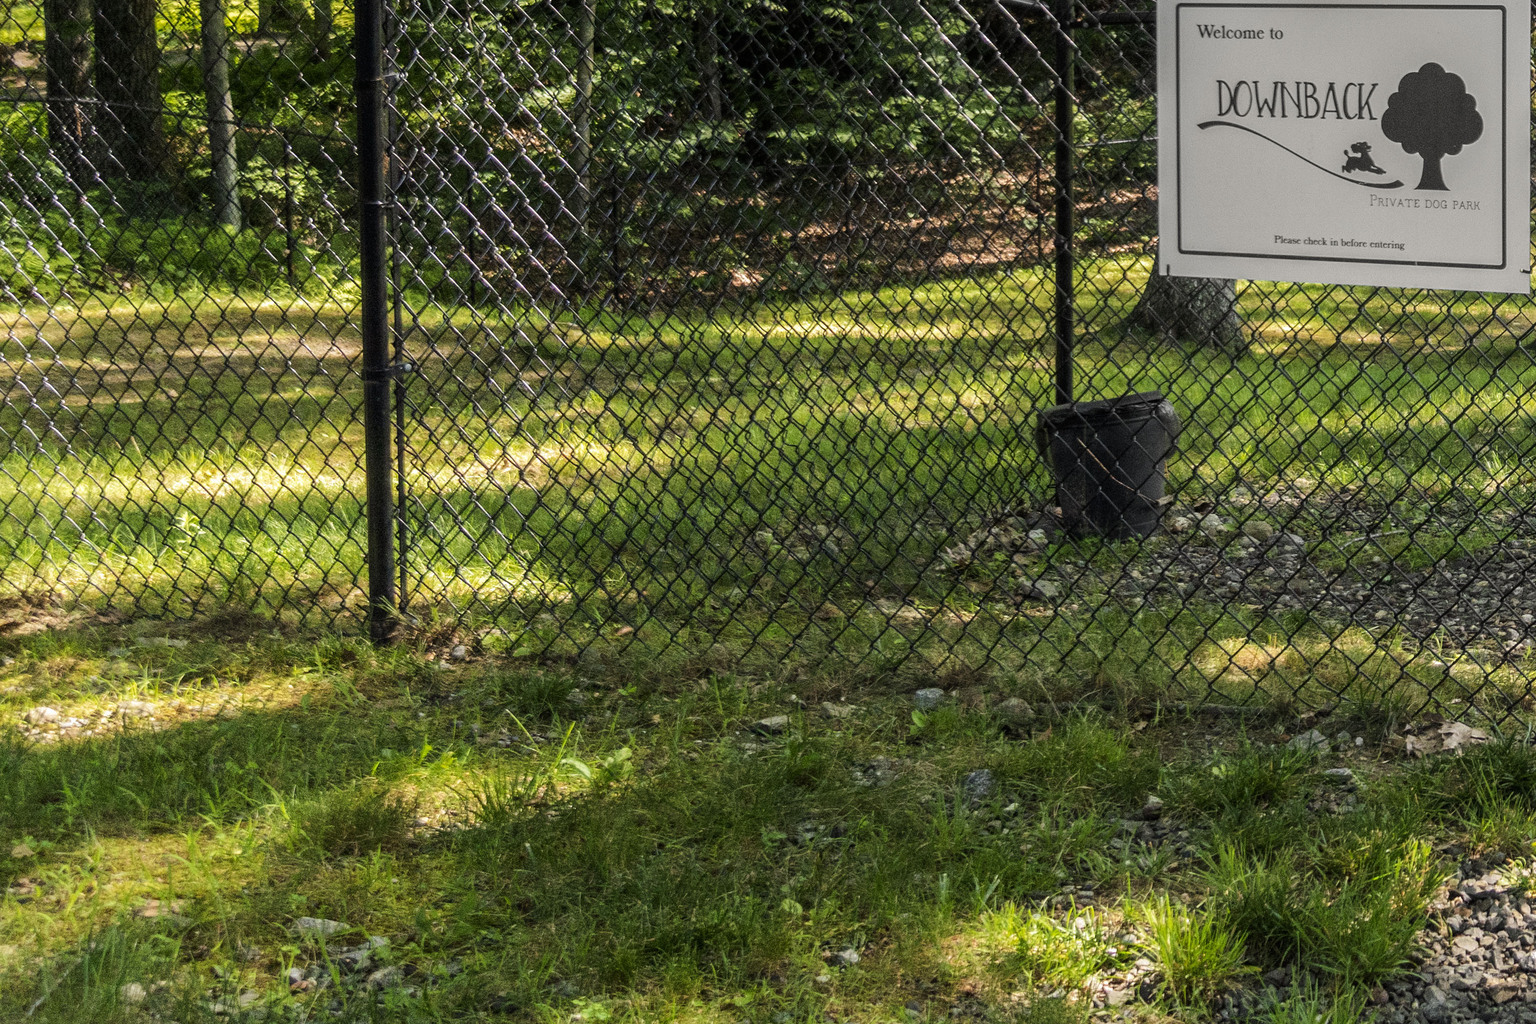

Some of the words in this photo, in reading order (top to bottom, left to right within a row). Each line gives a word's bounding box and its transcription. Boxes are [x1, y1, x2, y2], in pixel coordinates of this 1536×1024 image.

[1197, 24, 1265, 40] Welcome
[1269, 26, 1284, 40] to
[1216, 79, 1379, 121] DOWNBACK
[1273, 234, 1301, 246] Please
[1303, 235, 1328, 246] check
[1330, 237, 1339, 247] in
[1340, 237, 1367, 248] before
[1369, 239, 1406, 251] entering
